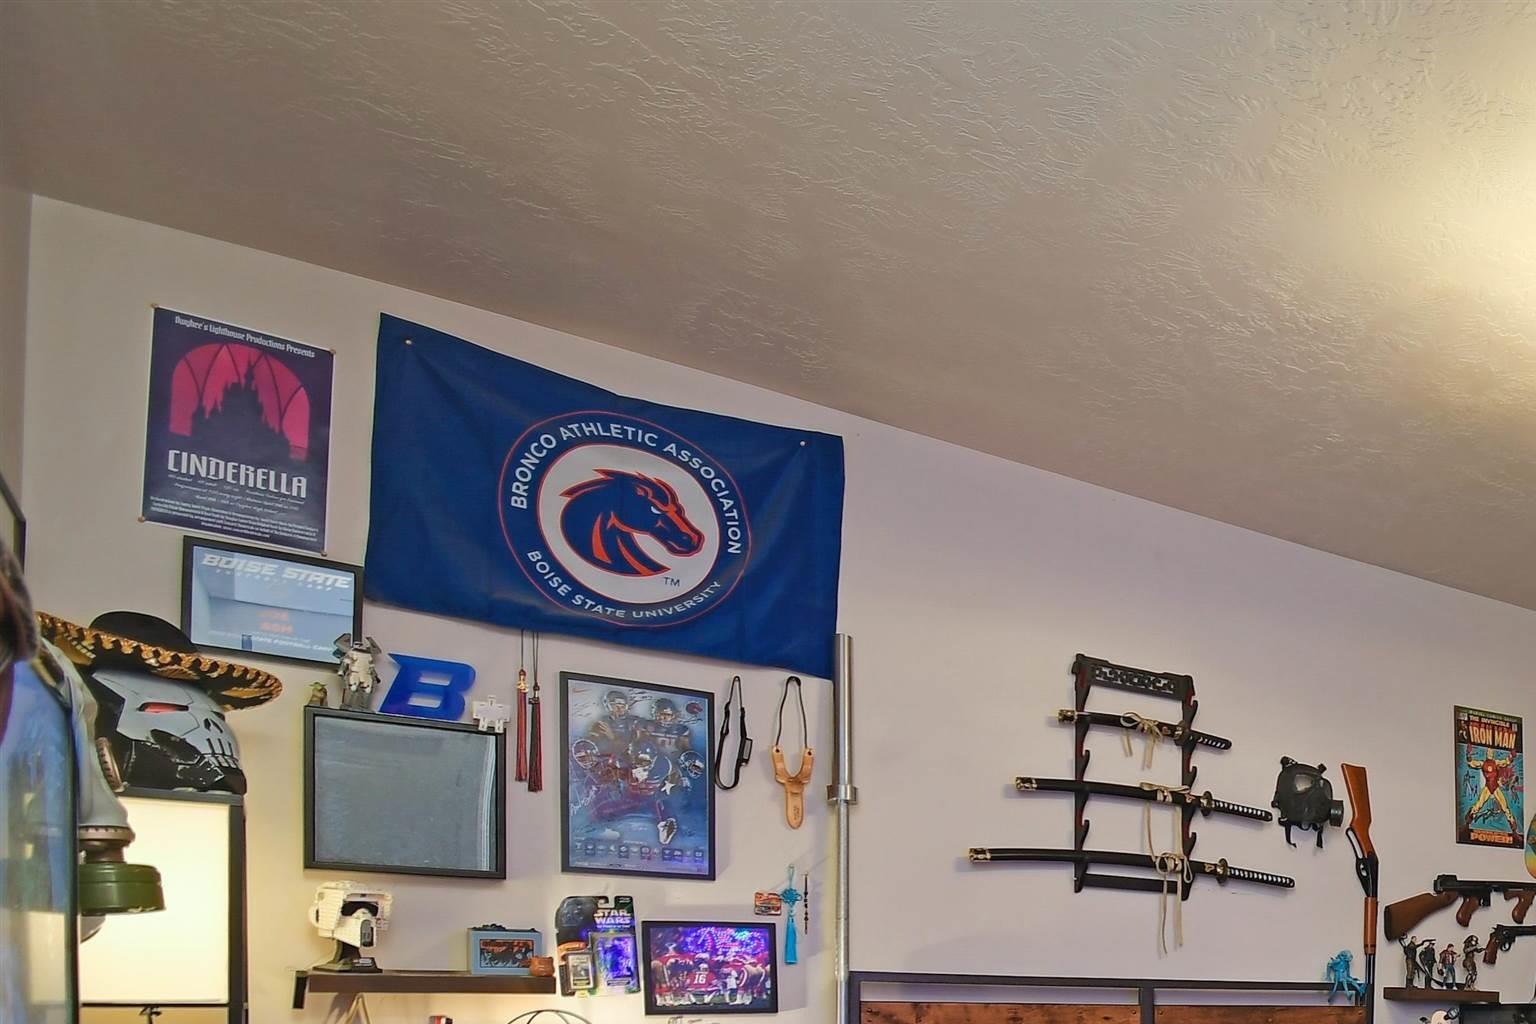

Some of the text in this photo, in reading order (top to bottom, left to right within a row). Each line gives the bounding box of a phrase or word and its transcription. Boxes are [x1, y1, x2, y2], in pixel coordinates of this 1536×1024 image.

[167, 449, 307, 498] CINDERELLA
[511, 421, 742, 554] BRONCO ATHLETIC ASSOCIATION
[201, 553, 279, 576] BOISE
[282, 567, 353, 589] STATE
[663, 576, 681, 587] TM
[527, 550, 722, 618] BOISE STATE UNIVERSITY
[1469, 725, 1517, 749] IRON MAN
[593, 909, 631, 917] STAR
[594, 916, 632, 925] WARS
[693, 974, 706, 985] 16
